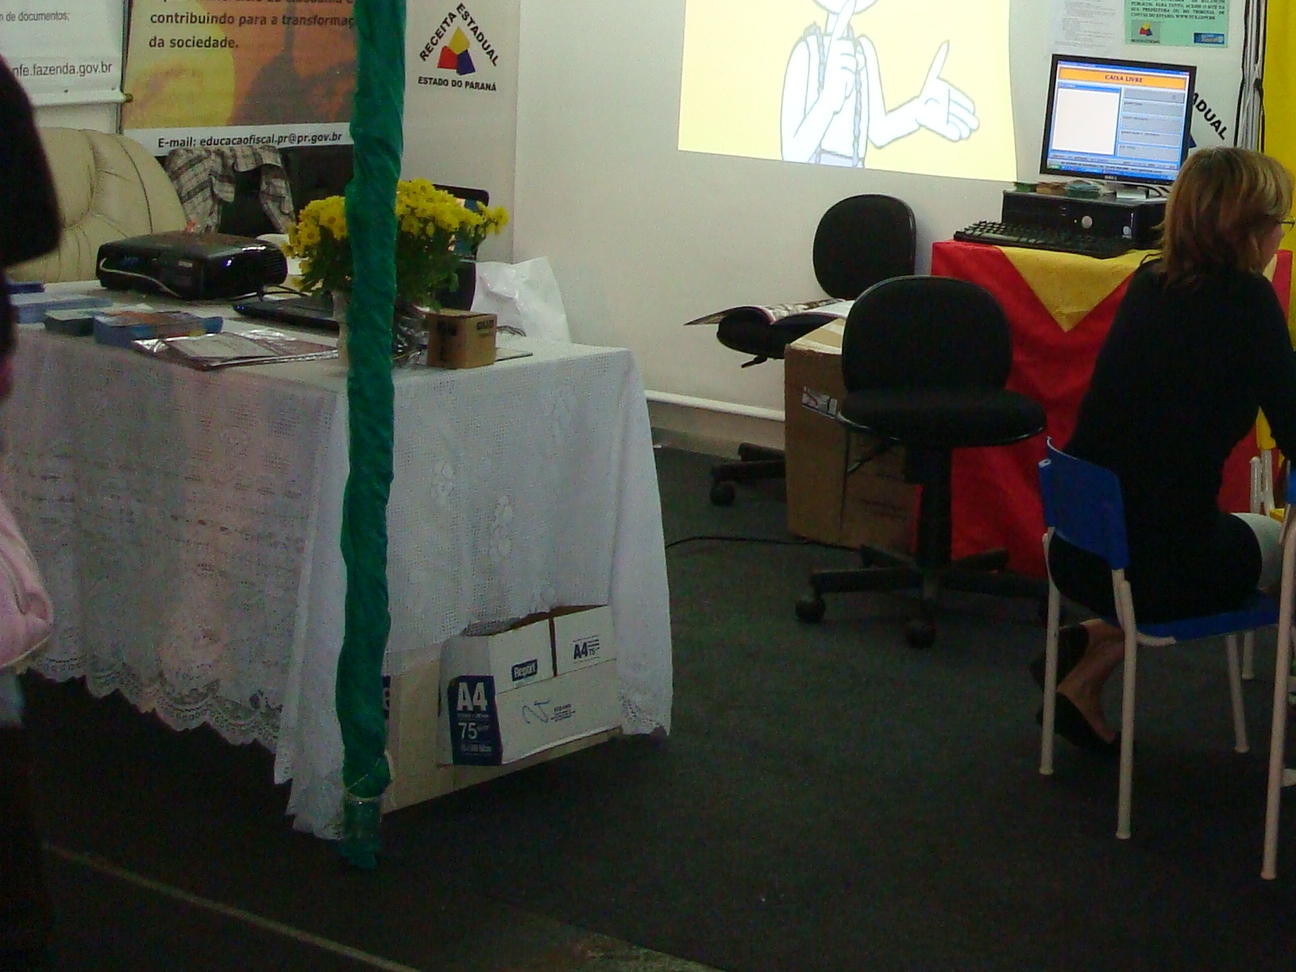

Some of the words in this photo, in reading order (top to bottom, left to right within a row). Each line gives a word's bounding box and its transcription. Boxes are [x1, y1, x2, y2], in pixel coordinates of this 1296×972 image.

[6, 12, 16, 22] de
[18, 11, 70, 22] documentos;
[150, 12, 234, 25] contribuindo
[238, 15, 266, 28] para
[270, 16, 278, 26] a
[419, 12, 457, 62] RECEITA
[456, 2, 498, 66] ESTADUAL
[149, 36, 165, 48] da
[170, 36, 239, 49] sociedade.
[418, 76, 448, 87] ESTADO
[452, 80, 462, 88] DO
[464, 82, 496, 92] PARANÁ
[1104, 74, 1124, 82] CAIXA
[1125, 76, 1143, 84] LIVRE
[158, 136, 197, 148] E-mail:
[200, 132, 342, 147] educacaofiscal.pr@pr.gov.br
[574, 642, 588, 660] A4
[456, 682, 488, 712] A4
[458, 722, 478, 740] 75
